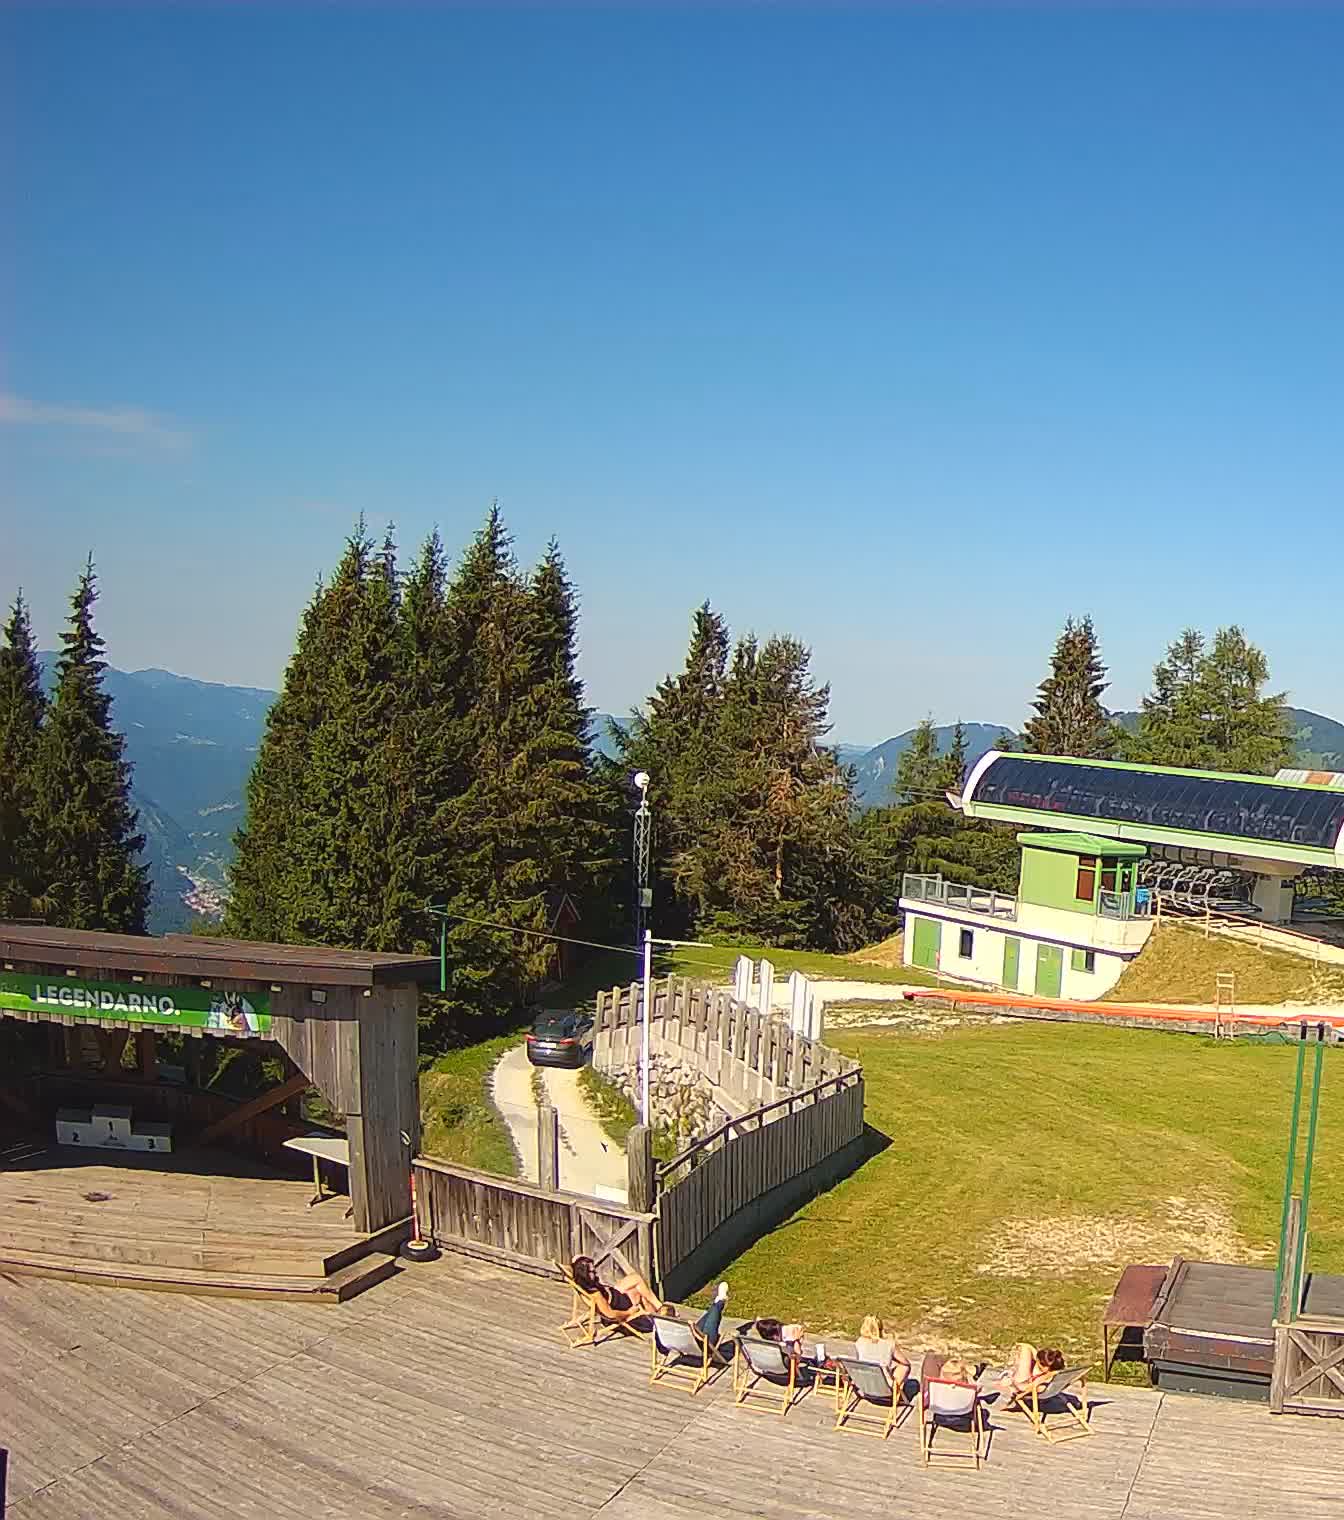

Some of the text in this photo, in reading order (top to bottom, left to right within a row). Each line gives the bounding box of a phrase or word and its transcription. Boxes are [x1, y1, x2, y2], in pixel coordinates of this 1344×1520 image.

[36, 984, 181, 1016] LEGENDARNO.
[72, 1131, 80, 1142] 2
[147, 1138, 155, 1149] 3
